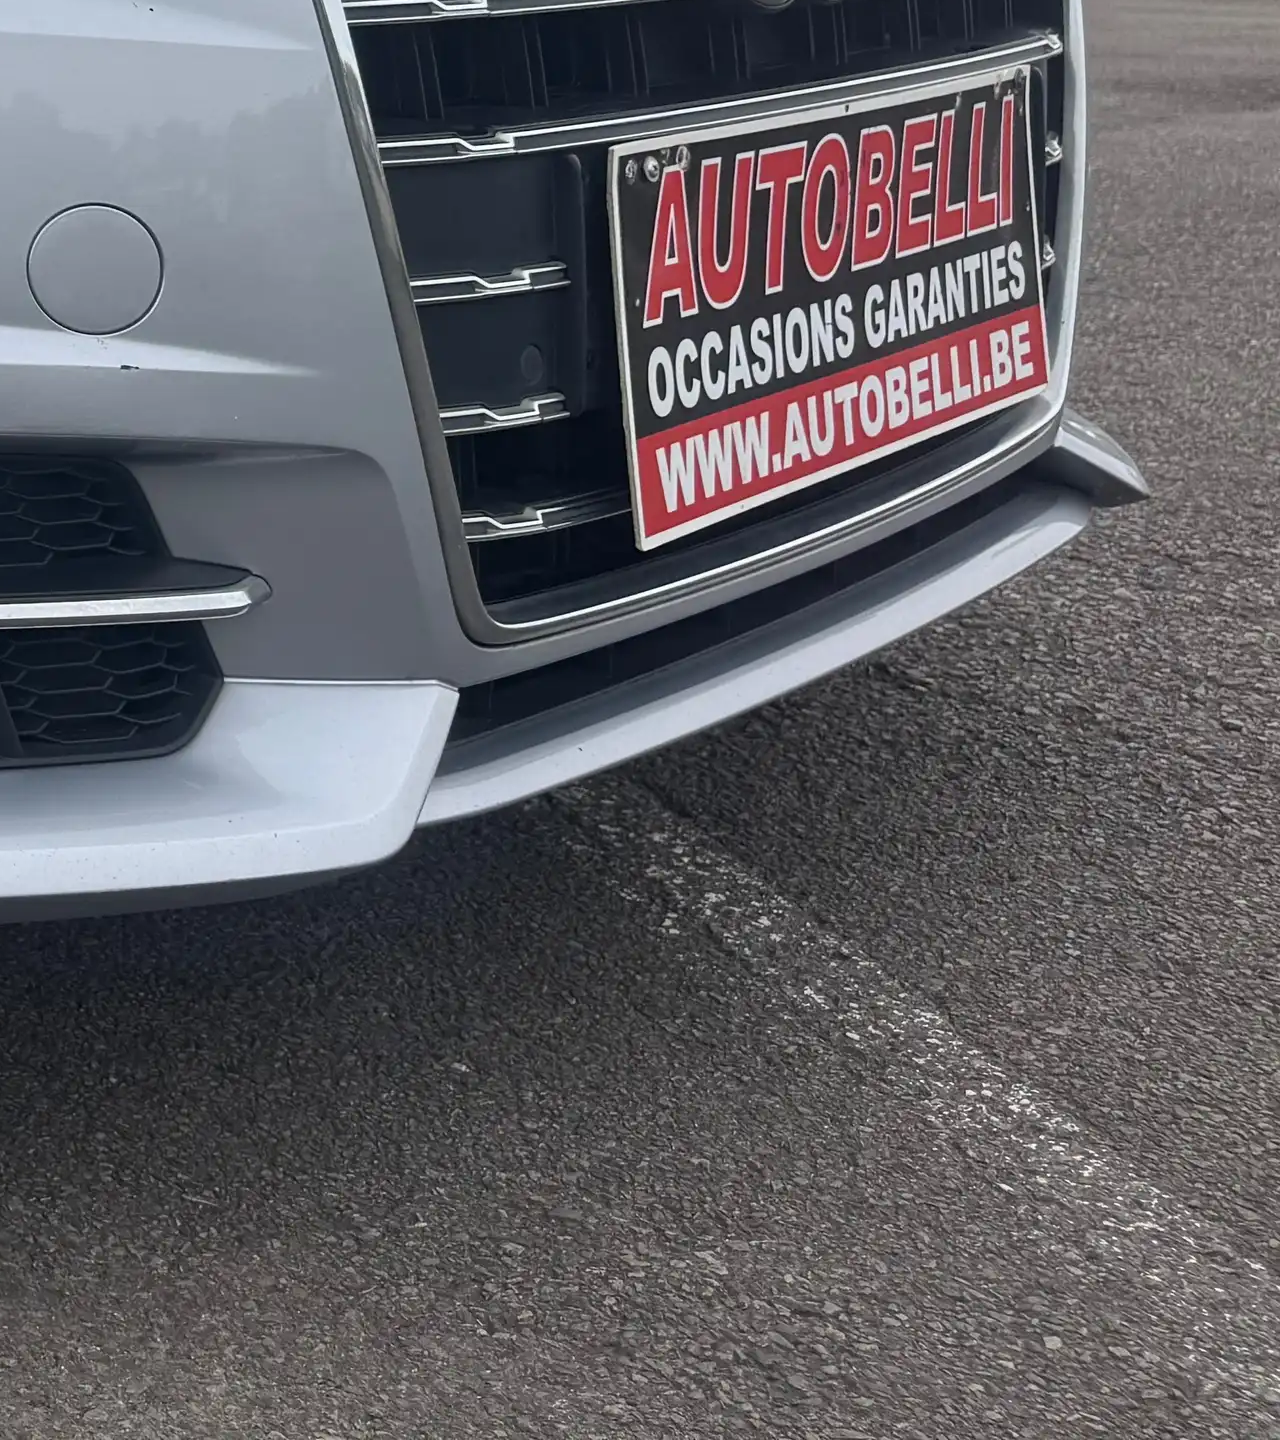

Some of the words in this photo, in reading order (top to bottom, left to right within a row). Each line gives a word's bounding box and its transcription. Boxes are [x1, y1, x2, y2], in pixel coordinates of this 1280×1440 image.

[643, 95, 1015, 329] AUTOBELLI
[647, 299, 856, 418] OCCASIONS
[863, 240, 1025, 348] GARANTIES
[655, 321, 1034, 514] WWW.AUTOBELLI.BE
